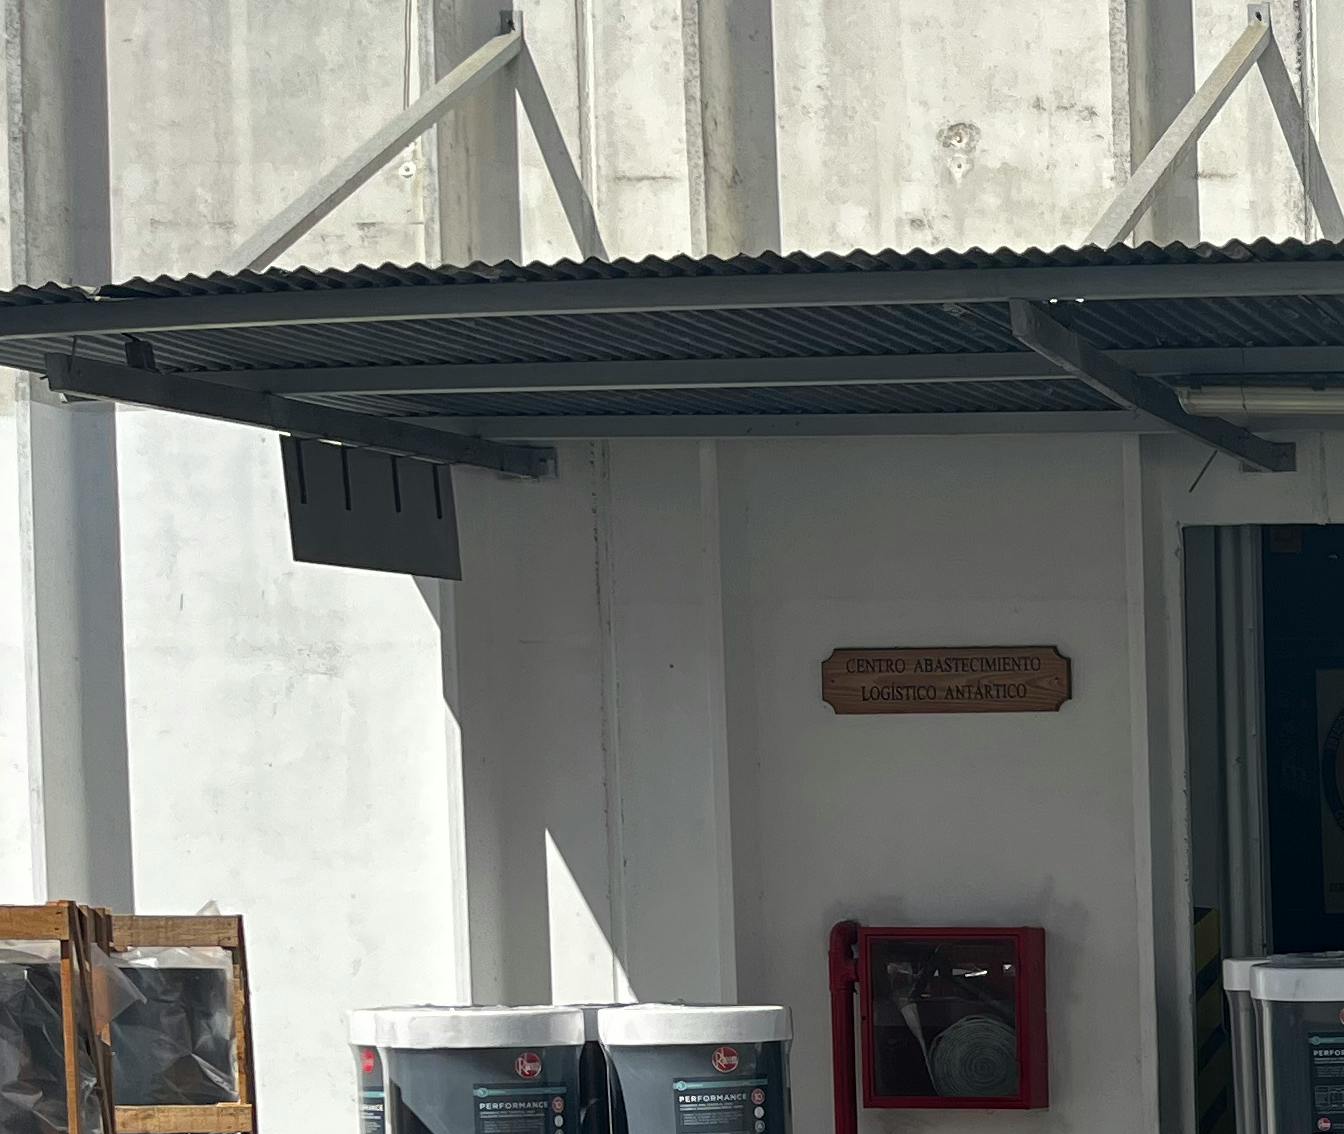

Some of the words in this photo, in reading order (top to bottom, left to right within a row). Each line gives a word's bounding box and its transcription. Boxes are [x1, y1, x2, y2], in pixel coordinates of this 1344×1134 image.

[846, 658, 906, 673] CENTRO
[913, 656, 1041, 673] ABASTECIMIENTO
[861, 681, 937, 701] LOGÍSTICO
[943, 679, 1027, 700] ANTÁRTICO
[679, 1094, 747, 1103] PERFORMANCE
[479, 1101, 548, 1110] PERFORMANCE
